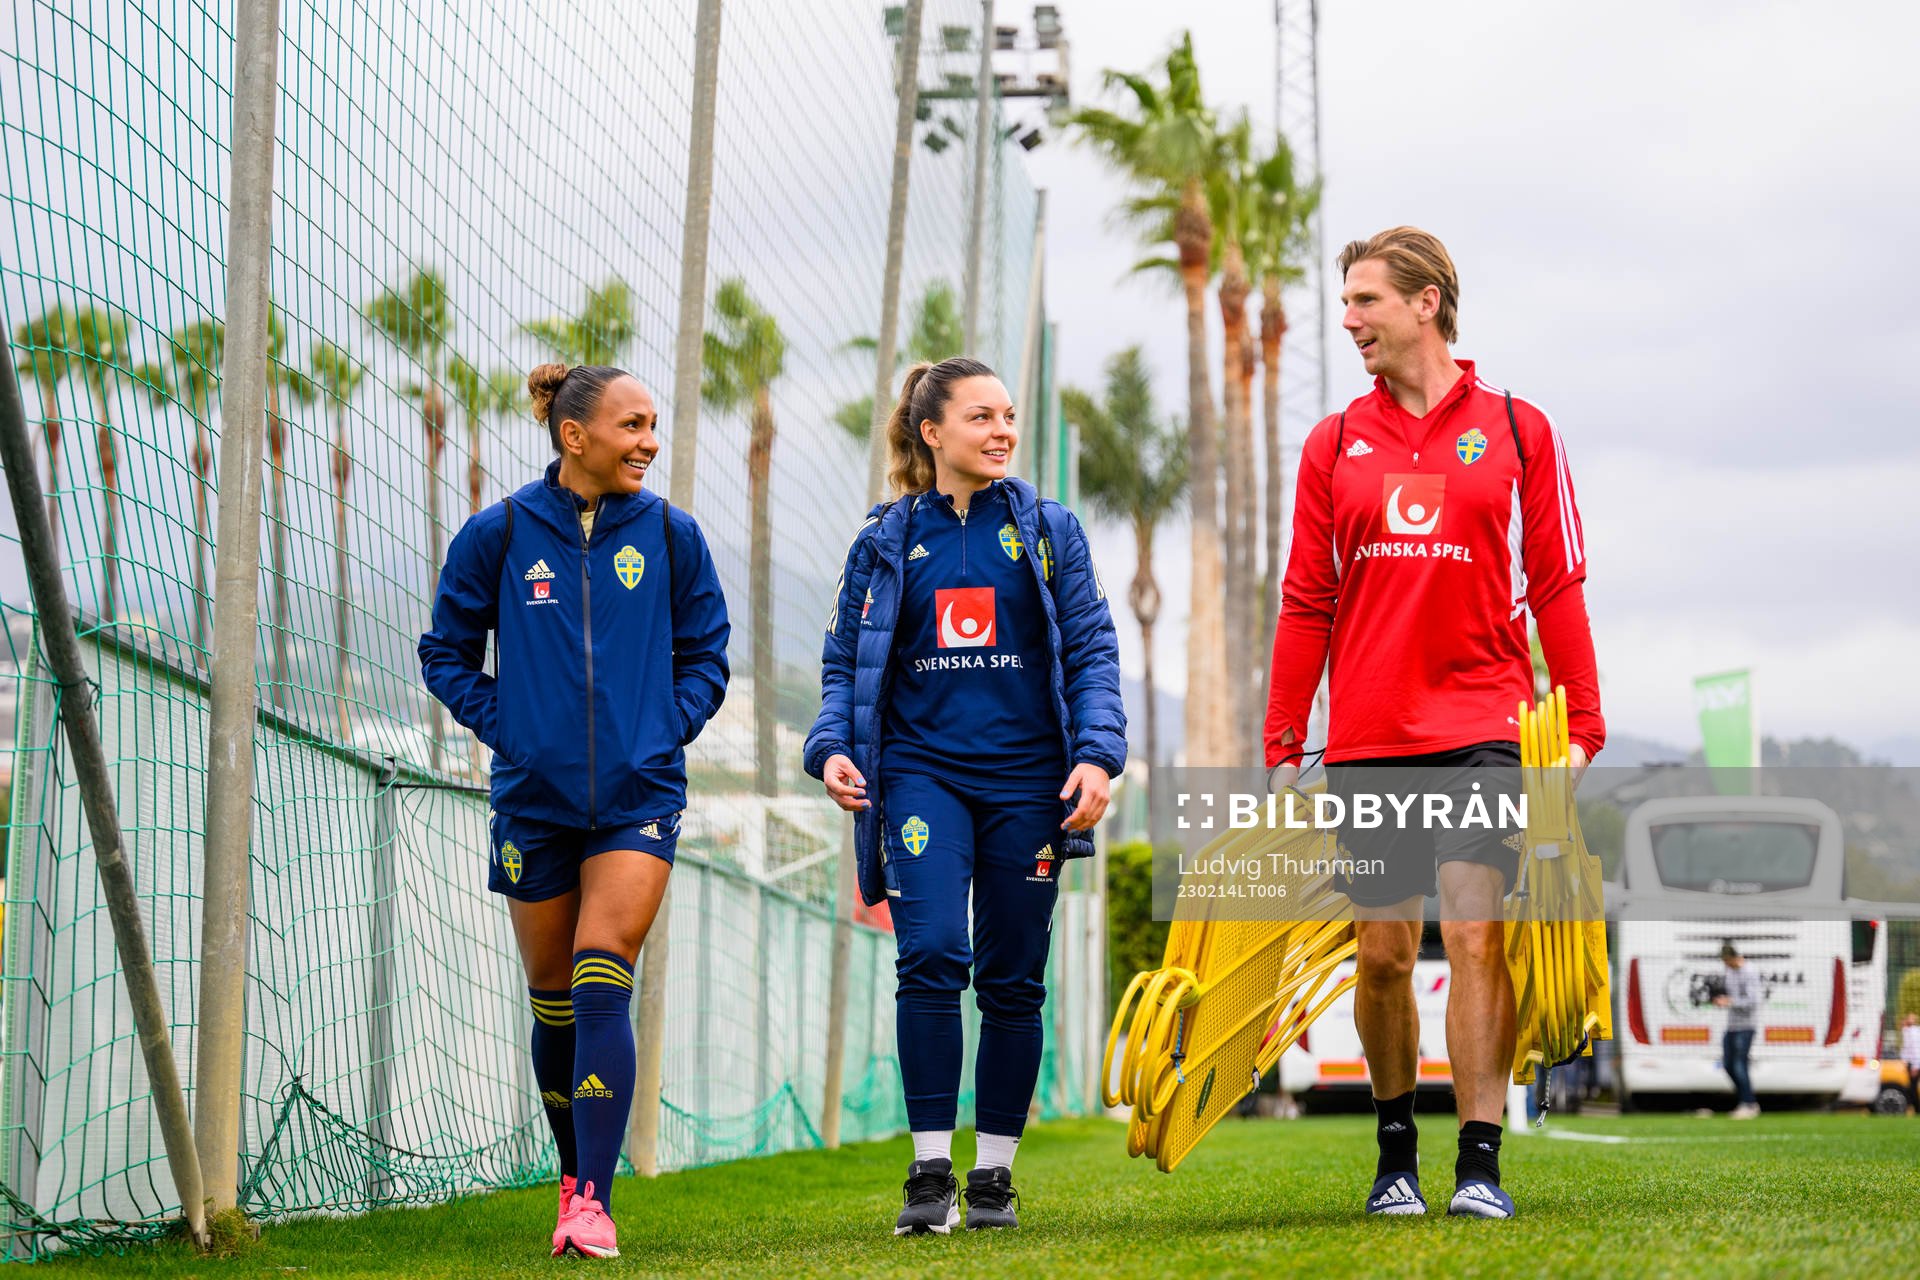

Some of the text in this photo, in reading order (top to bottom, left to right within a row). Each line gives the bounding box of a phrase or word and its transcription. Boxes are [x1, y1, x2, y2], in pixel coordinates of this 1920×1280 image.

[908, 551, 930, 561] adidas
[1354, 542, 1473, 562] SVENSKA SPEL
[524, 571, 556, 581] adidas
[914, 655, 1024, 672] SVENSKA SPEL
[574, 1089, 614, 1099] adidas
[1372, 1195, 1422, 1206] adidas
